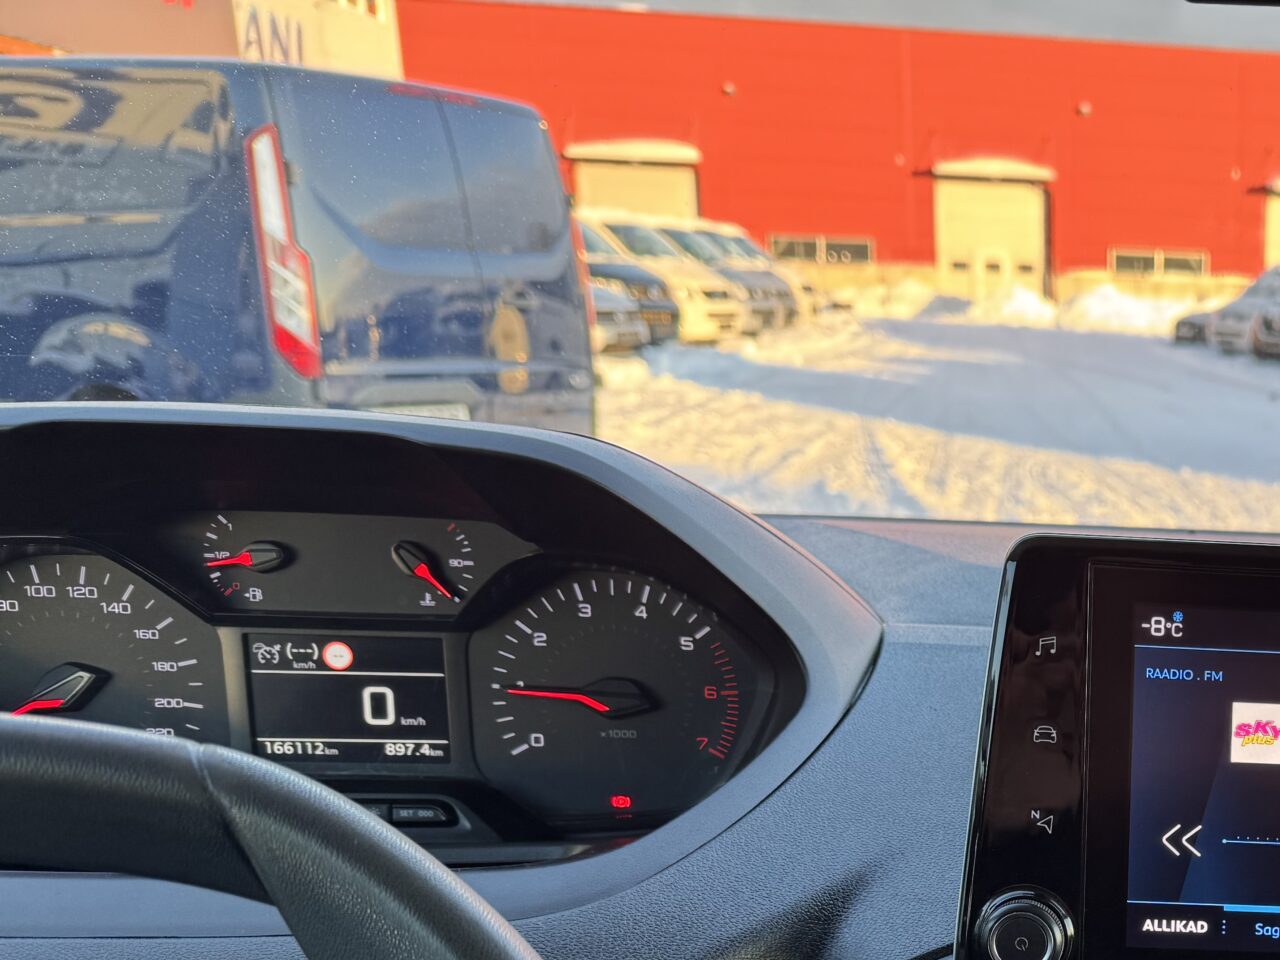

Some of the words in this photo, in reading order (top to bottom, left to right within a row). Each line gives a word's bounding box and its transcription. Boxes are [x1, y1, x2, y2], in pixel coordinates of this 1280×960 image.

[214, 551, 230, 559] 1/2
[449, 559, 464, 567] 90
[24, 585, 56, 598] 100
[66, 586, 98, 599] 120
[100, 602, 132, 615] 140
[578, 603, 592, 618] 3
[635, 605, 648, 619] 4
[133, 629, 160, 640] 160
[533, 632, 547, 646] 2
[680, 636, 694, 651] 5
[151, 661, 178, 672] 180
[293, 661, 316, 670] km/h
[1146, 667, 1194, 681] RAADIO
[1204, 671, 1223, 682] FM
[705, 686, 717, 699] 6
[154, 698, 184, 708] 200
[362, 686, 395, 726] 0
[401, 717, 426, 726] km/h
[530, 733, 544, 747] 0
[696, 737, 708, 750] 7
[1031, 810, 1040, 819] N
[1142, 918, 1209, 934] ALLIKAD
